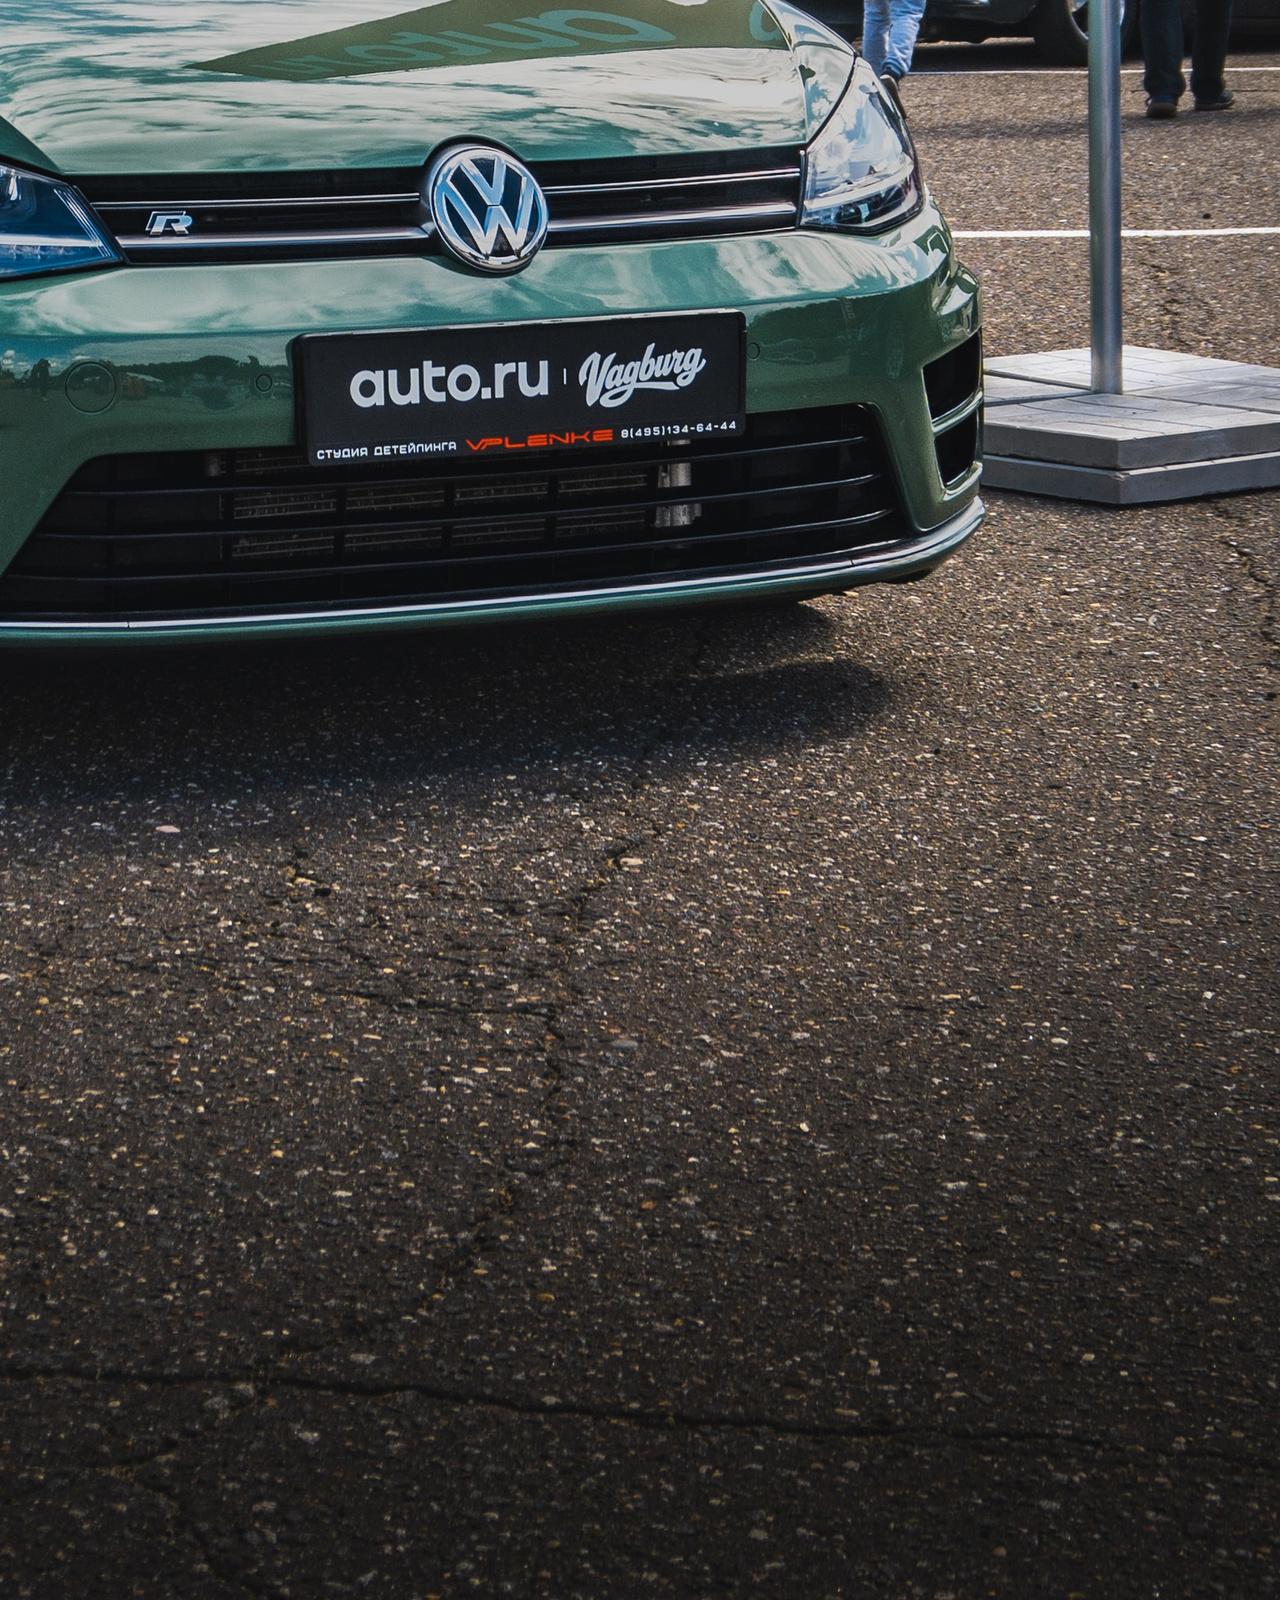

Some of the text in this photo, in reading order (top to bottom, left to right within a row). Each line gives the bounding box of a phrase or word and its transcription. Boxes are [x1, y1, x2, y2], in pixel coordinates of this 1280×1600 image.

[145, 210, 193, 236] R
[349, 342, 707, 408] auto.ru Vagburg
[316, 420, 737, 460] СТУДИЯ ДЕТЕЙЛИНГА VPLENKE 8(495)134-64-44
